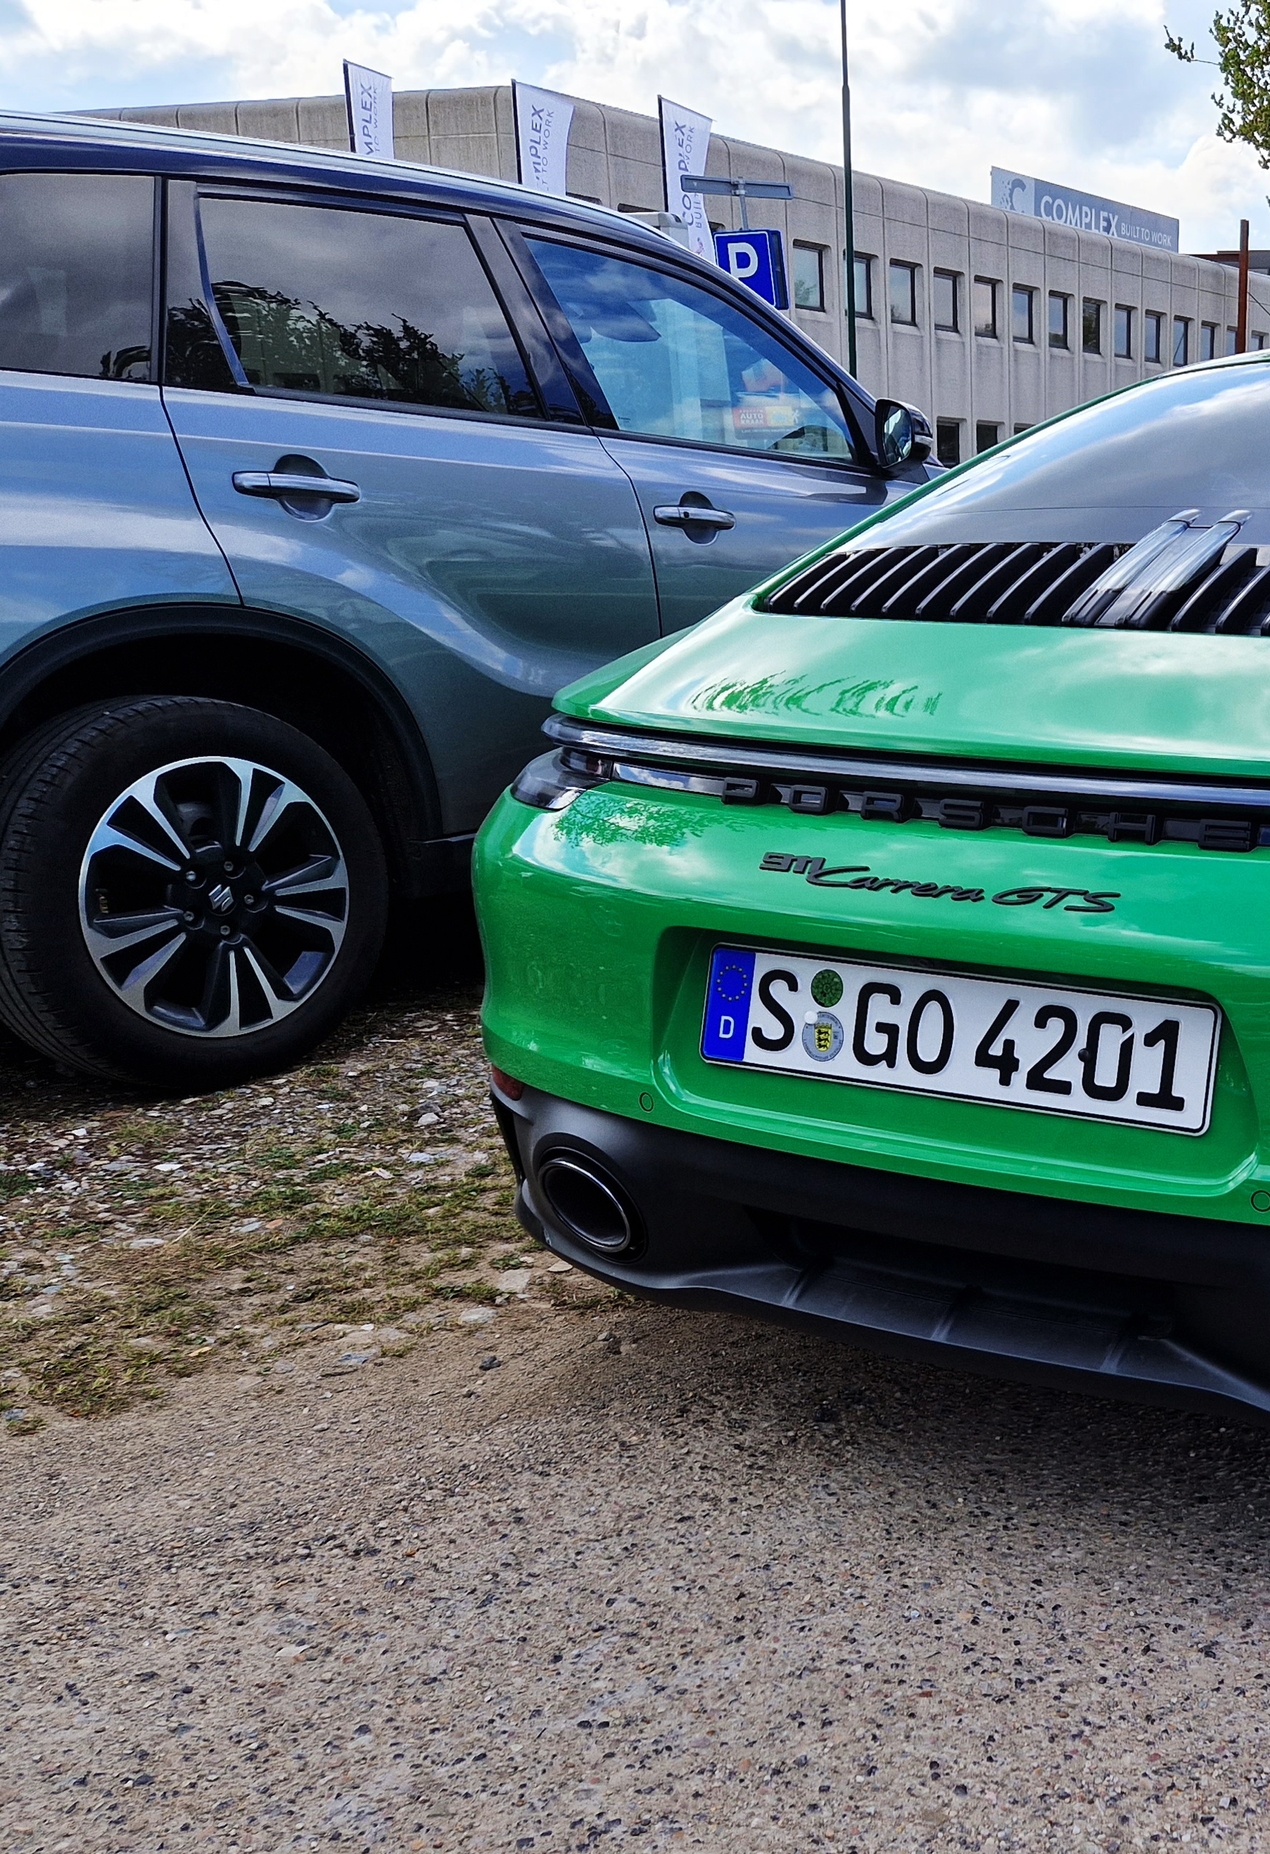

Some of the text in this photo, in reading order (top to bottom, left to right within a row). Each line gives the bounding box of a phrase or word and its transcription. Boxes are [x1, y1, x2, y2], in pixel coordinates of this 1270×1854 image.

[1040, 195, 1172, 247] COMPLEX BUILT TO WORK
[727, 242, 759, 279] P
[722, 776, 1252, 850] PORSCHE
[759, 851, 1121, 913] 911 Carrera GTS
[719, 1015, 735, 1039] D
[751, 969, 799, 1052] S
[852, 982, 955, 1076] GO
[974, 998, 1186, 1112] 4201
